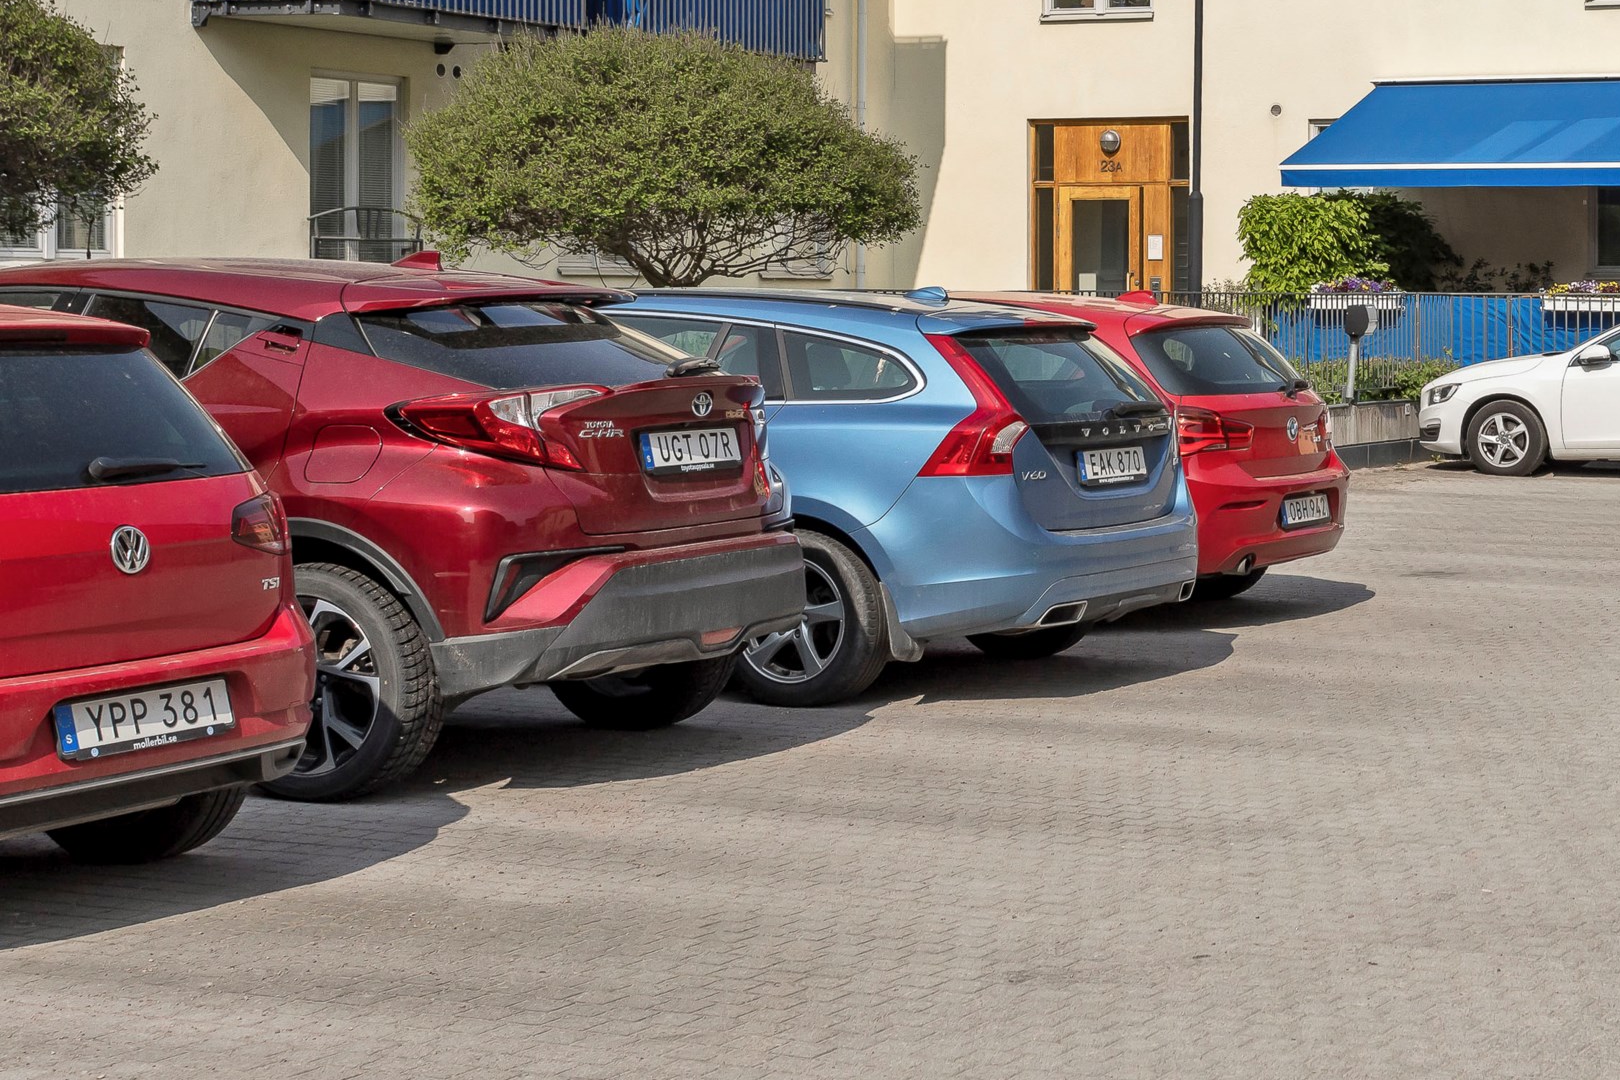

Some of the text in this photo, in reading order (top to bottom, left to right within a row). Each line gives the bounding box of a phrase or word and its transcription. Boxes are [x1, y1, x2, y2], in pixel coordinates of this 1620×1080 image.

[1100, 160, 1122, 172] 23A
[584, 420, 615, 429] TOYOTA
[1081, 424, 1154, 437] VOLVO
[657, 434, 693, 462] UGT
[698, 431, 733, 460] 07R
[1090, 449, 1141, 476] EAK 870
[1021, 470, 1047, 481] V60
[262, 577, 280, 591] TSI
[65, 686, 217, 745] S YPP 381
[133, 734, 178, 750] mollerbil.se
